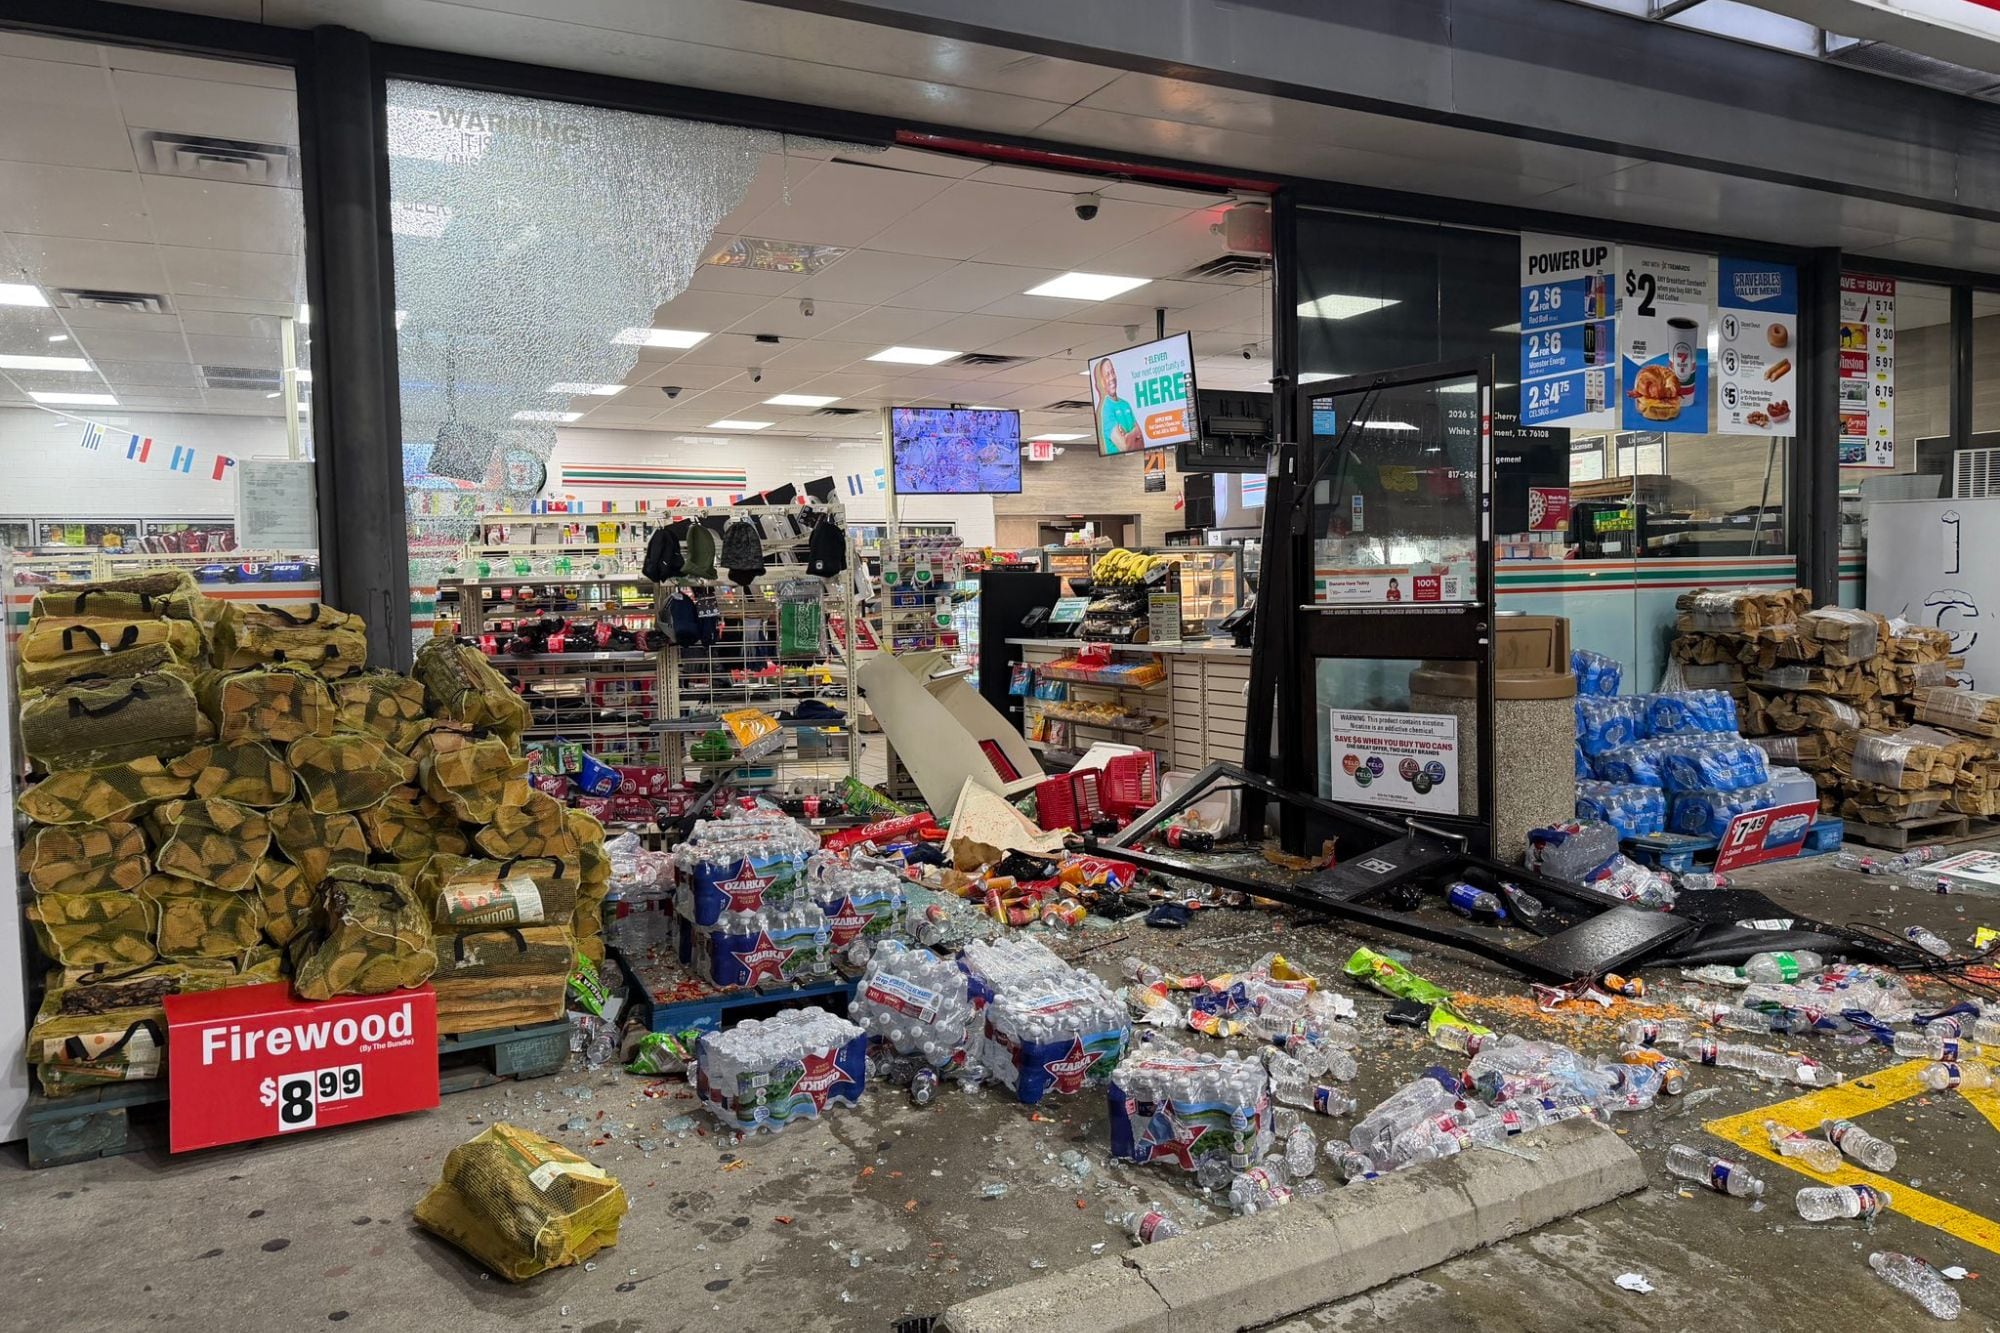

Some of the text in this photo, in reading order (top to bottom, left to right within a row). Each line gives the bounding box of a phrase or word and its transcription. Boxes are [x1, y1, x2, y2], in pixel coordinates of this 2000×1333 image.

[1529, 247, 1607, 275] POWER UP
[1734, 273, 1781, 287] CRAVEABLES
[1840, 277, 1857, 289] AVE
[1867, 280, 1884, 292] BUY
[1886, 282, 1892, 293] 2
[1529, 290, 1539, 312] 2
[1545, 286, 1561, 309] $6
[1626, 269, 1656, 316] $2
[1735, 287, 1781, 296] VALUE MENU
[1725, 319, 1734, 337] $1
[1529, 332, 1561, 358] 2 FOR $6
[1529, 357, 1566, 369] Monster Energy
[1840, 354, 1864, 369] inston
[1135, 372, 1186, 408] HERE
[1529, 386, 1539, 409] 2
[1540, 398, 1549, 406] FOR
[1448, 411, 1467, 419] 2026
[1529, 407, 1549, 418] CELSIUS
[1448, 427, 1470, 436] White
[1530, 430, 1549, 438] 76108
[1034, 445, 1051, 458] EXIT
[1417, 579, 1438, 587] 100%
[1334, 735, 1352, 743] SAVE
[1363, 737, 1383, 746] WHEN
[1384, 739, 1398, 747] YOU
[1399, 740, 1413, 748] BUY
[1415, 741, 1430, 749] TWO
[1431, 742, 1453, 751] CANS
[724, 879, 765, 891] OZARKA
[745, 950, 785, 968] OZARKA
[202, 1002, 413, 1066] Firewood
[359, 1038, 415, 1054] (By The Bundle)
[1051, 1055, 1092, 1072] OZARKA
[800, 1071, 841, 1091] OZARKA
